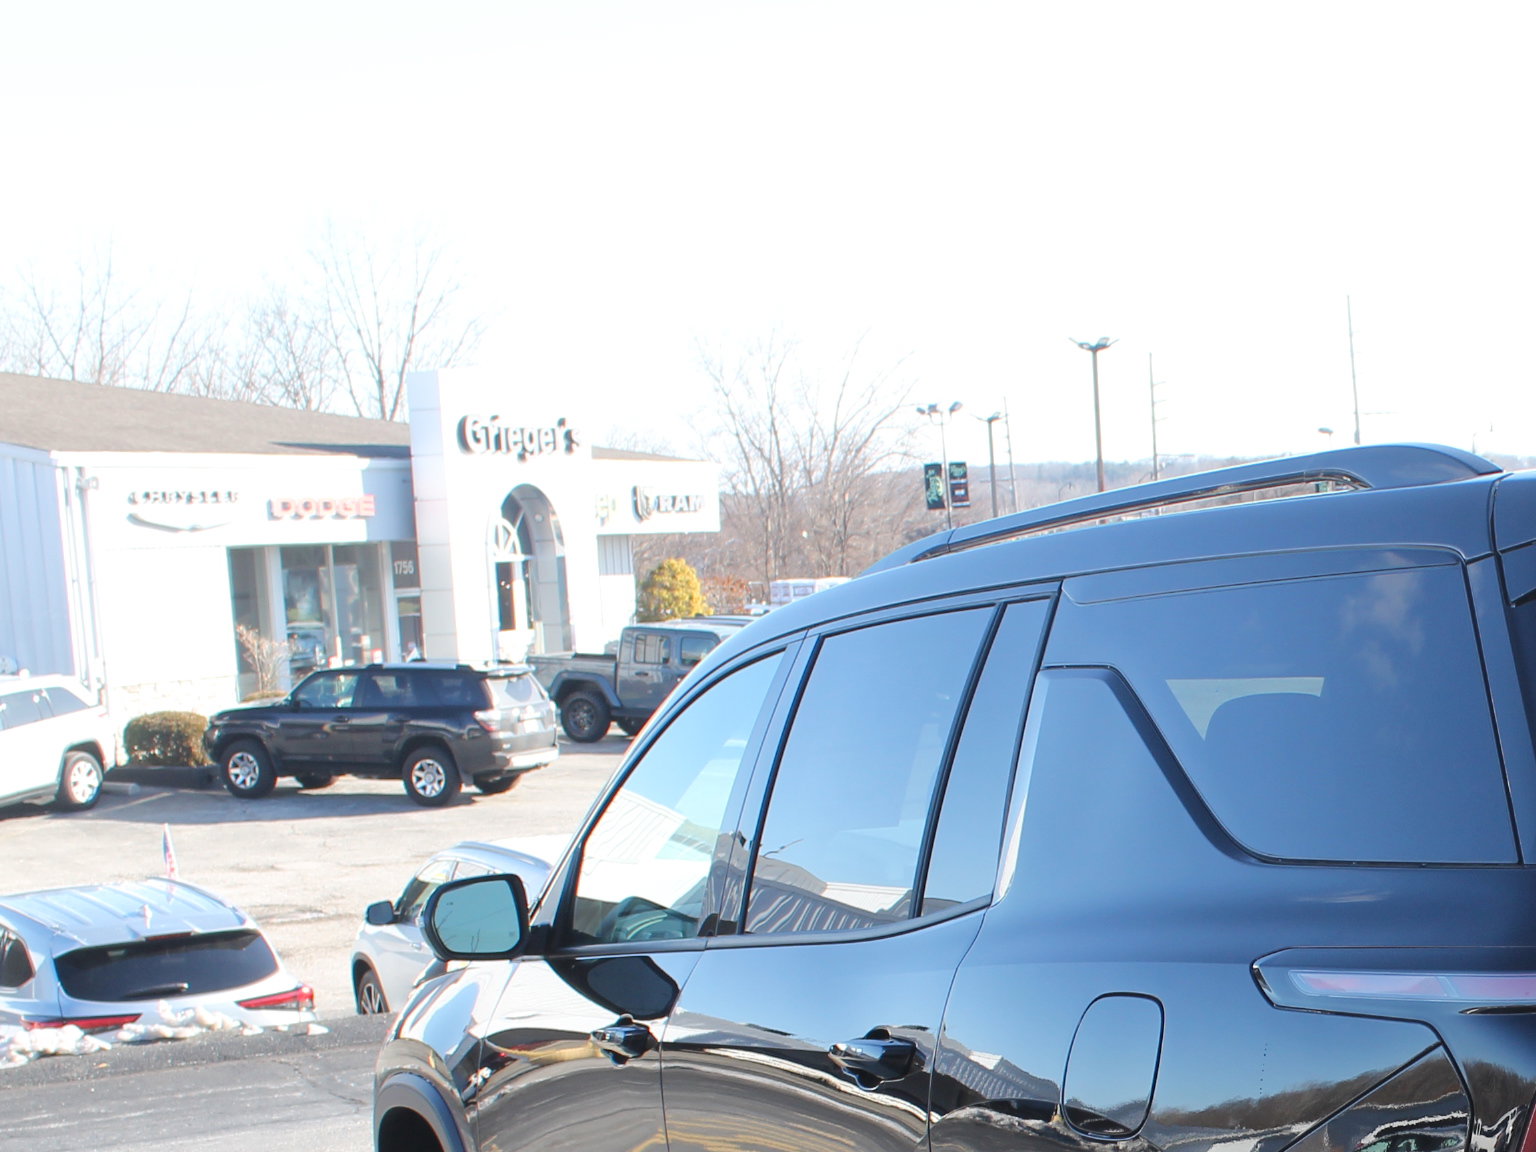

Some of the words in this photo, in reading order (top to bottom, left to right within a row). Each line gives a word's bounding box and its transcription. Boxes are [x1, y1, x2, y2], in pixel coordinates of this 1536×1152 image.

[456, 413, 580, 463] Grieger's
[265, 494, 376, 521] DODGE
[655, 494, 706, 514] RAM
[394, 560, 415, 575] 1756
